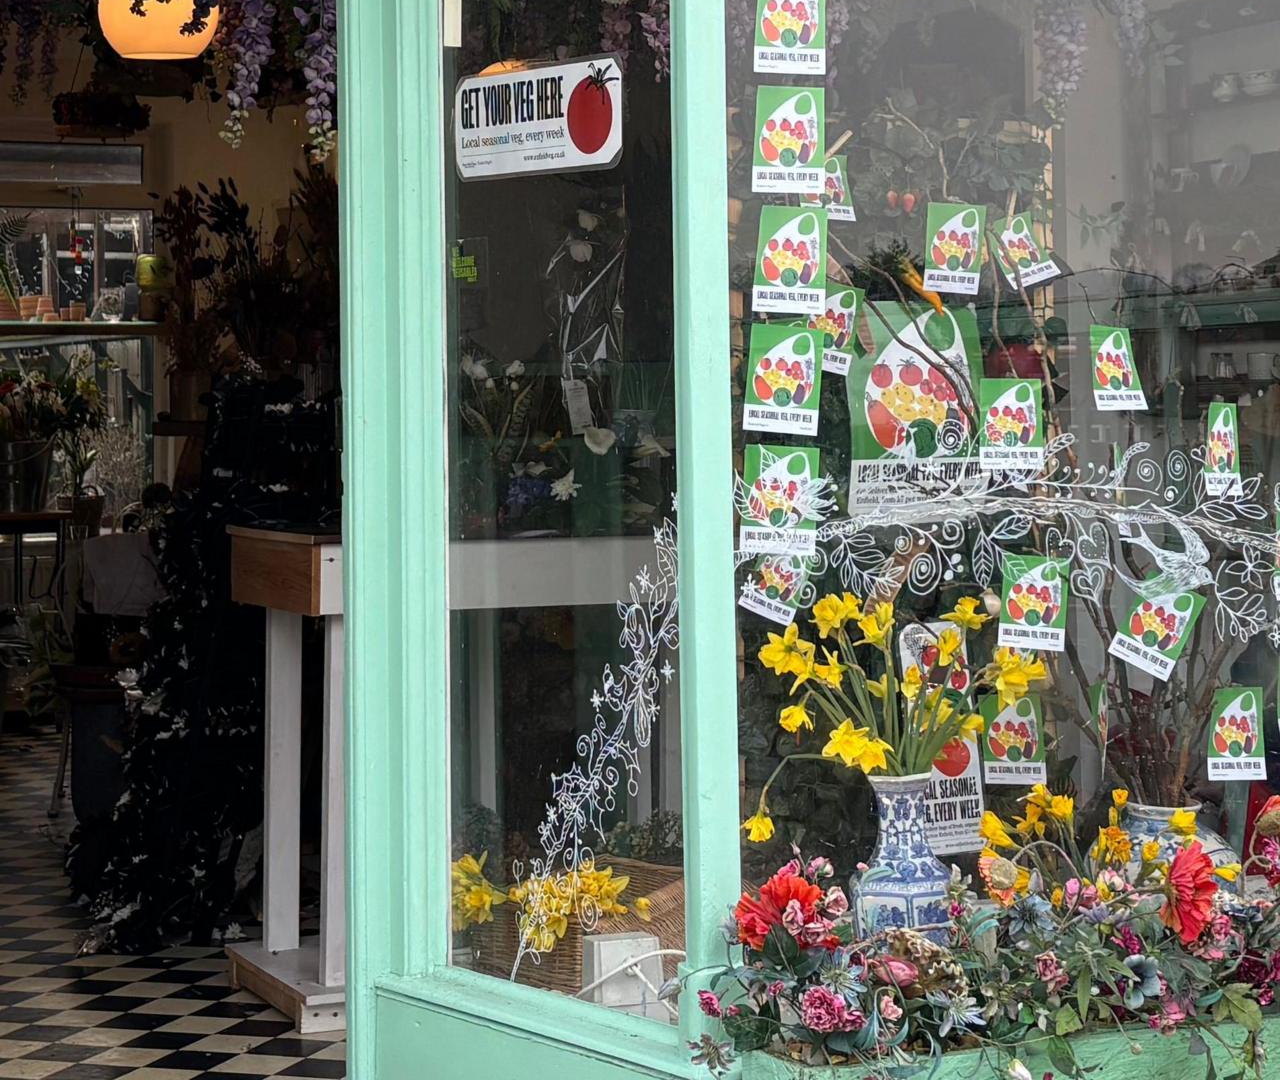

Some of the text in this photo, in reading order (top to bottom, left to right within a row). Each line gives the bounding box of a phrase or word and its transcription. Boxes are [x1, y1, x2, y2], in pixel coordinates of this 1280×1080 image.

[461, 75, 564, 129] GET YOUR VEG HERE
[462, 136, 480, 149] Local
[481, 132, 510, 147] seasonal
[525, 130, 544, 143] every
[545, 126, 565, 140] week
[939, 776, 979, 800] SEASONAL
[934, 801, 957, 823] EVERY
